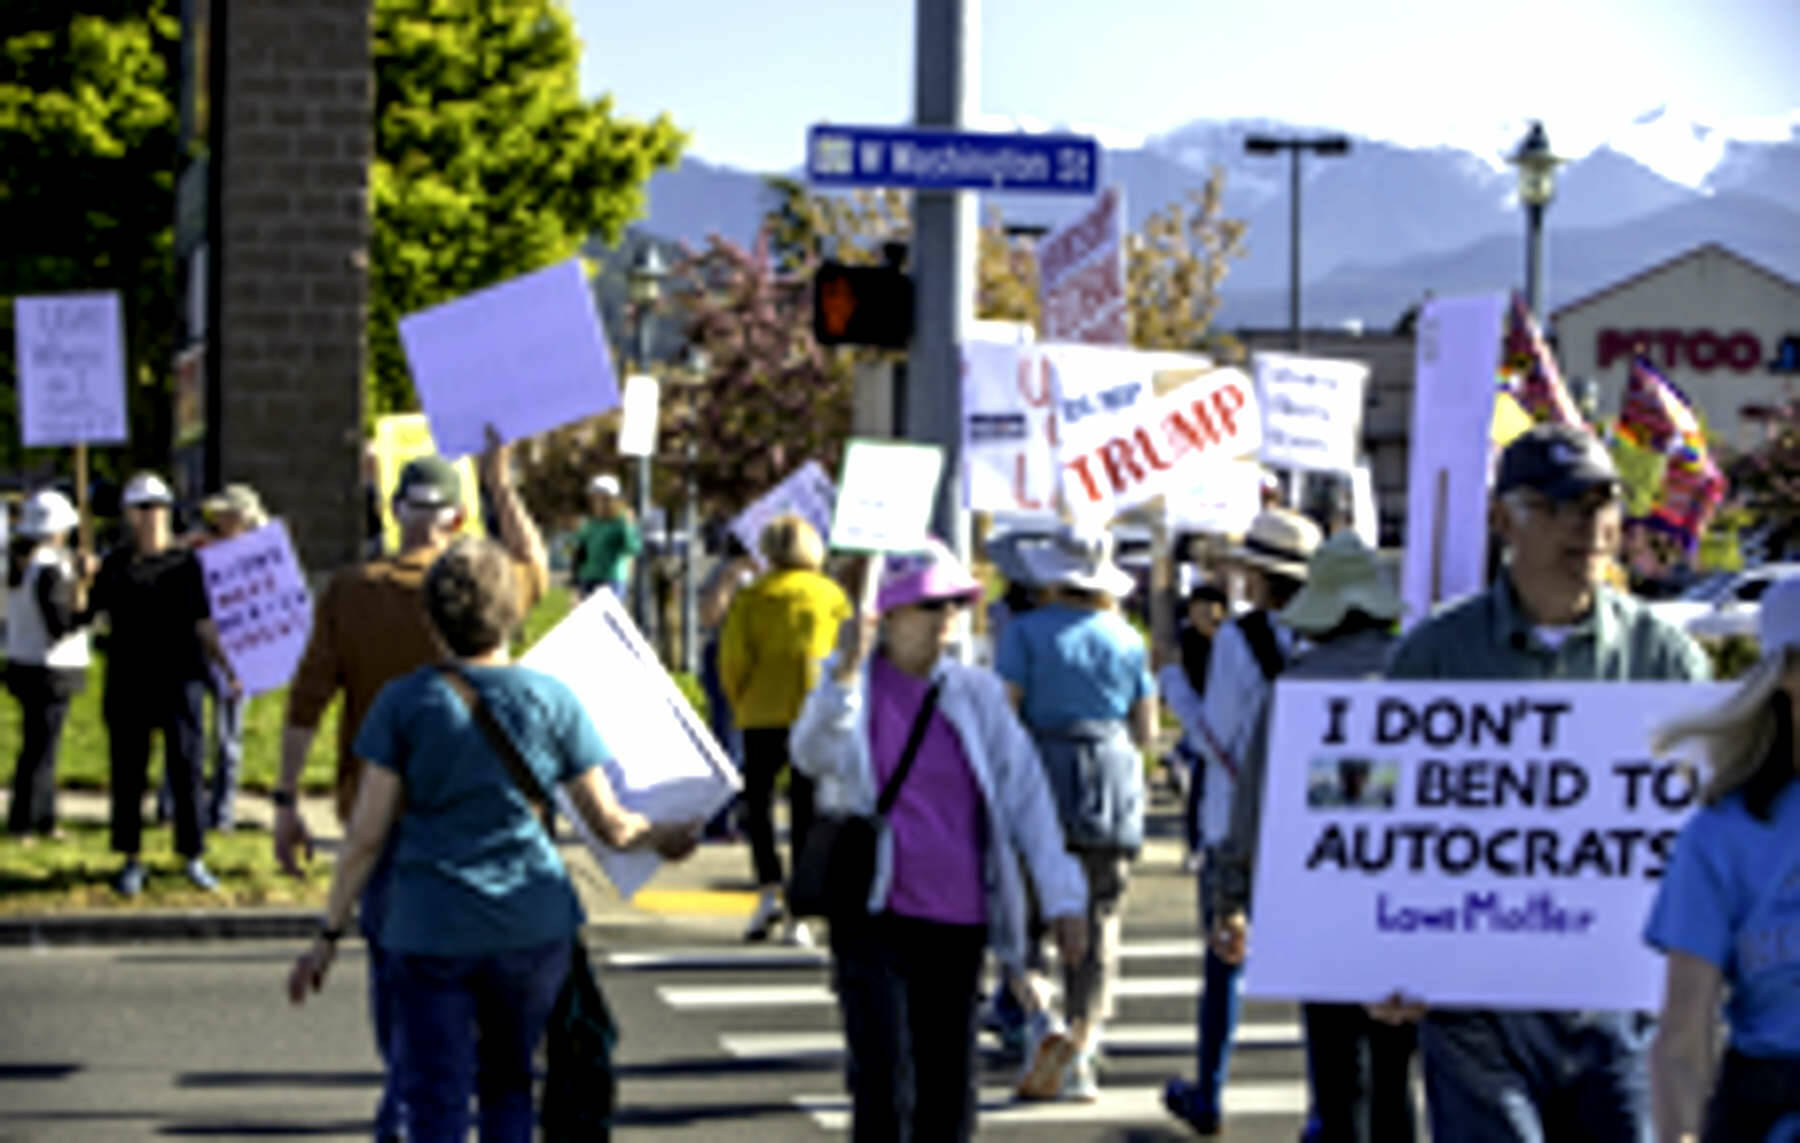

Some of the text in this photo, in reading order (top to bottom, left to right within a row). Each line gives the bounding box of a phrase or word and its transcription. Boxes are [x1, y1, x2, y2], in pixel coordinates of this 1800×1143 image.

[859, 140, 1091, 188] W Washington St
[1064, 382, 1246, 502] TRUMP
[1322, 697, 1572, 748] I DON'T
[1414, 759, 1700, 813] BEND TO
[1305, 821, 1676, 881] AUTOCRATS
